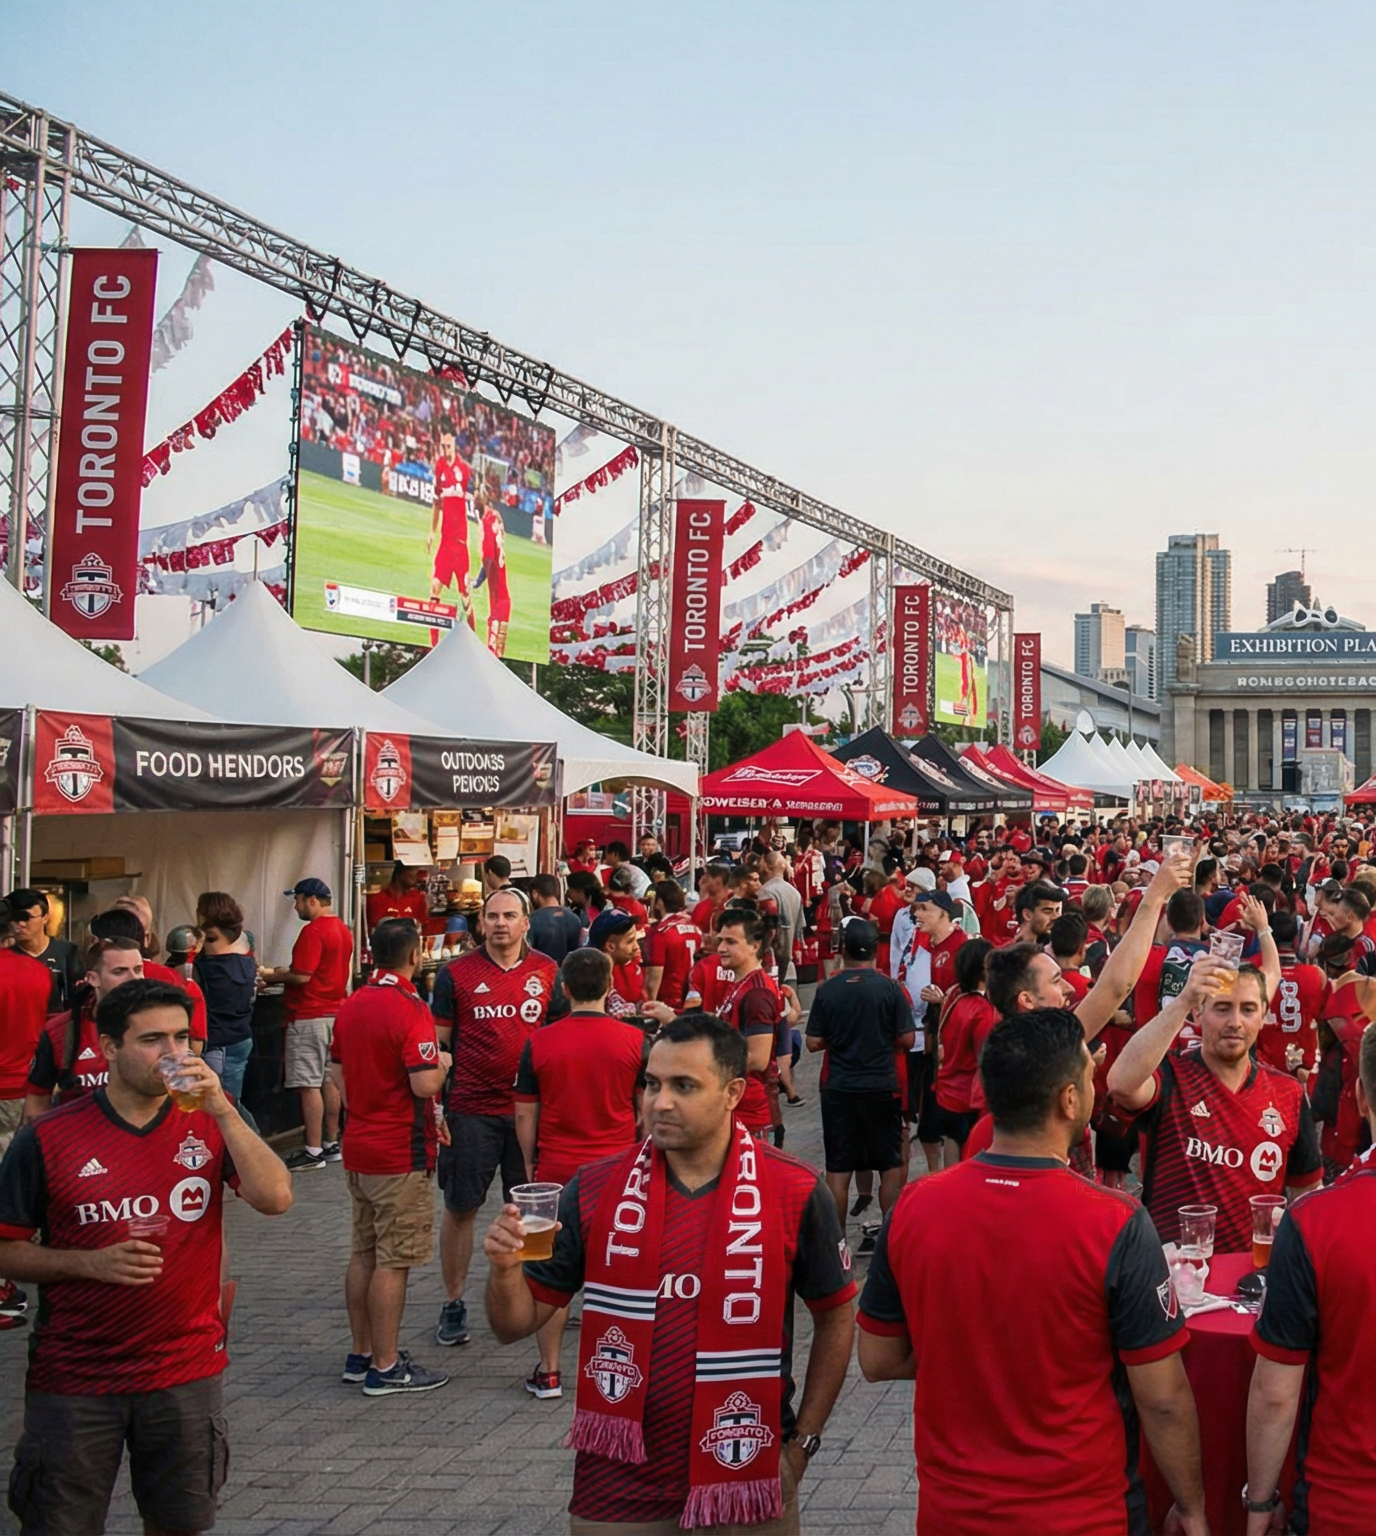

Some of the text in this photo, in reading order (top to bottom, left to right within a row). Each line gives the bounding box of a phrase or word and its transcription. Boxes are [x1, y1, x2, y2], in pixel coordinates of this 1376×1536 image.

[90, 275, 131, 323] FC
[76, 340, 125, 534] TORONTO
[684, 512, 711, 653] TORONTO FC
[903, 595, 920, 696] TORONTO FC
[1230, 638, 1338, 653] EXHIBITION
[1021, 639, 1035, 719] TORONTO FC
[135, 750, 305, 778] FOOD HENDORS
[473, 1004, 517, 1019] BMO
[1186, 1136, 1244, 1168] BMO
[75, 1194, 160, 1225] BMO
[605, 1134, 652, 1266] TOR
[722, 1121, 763, 1325] RONTO
[658, 1273, 701, 1299] MO
